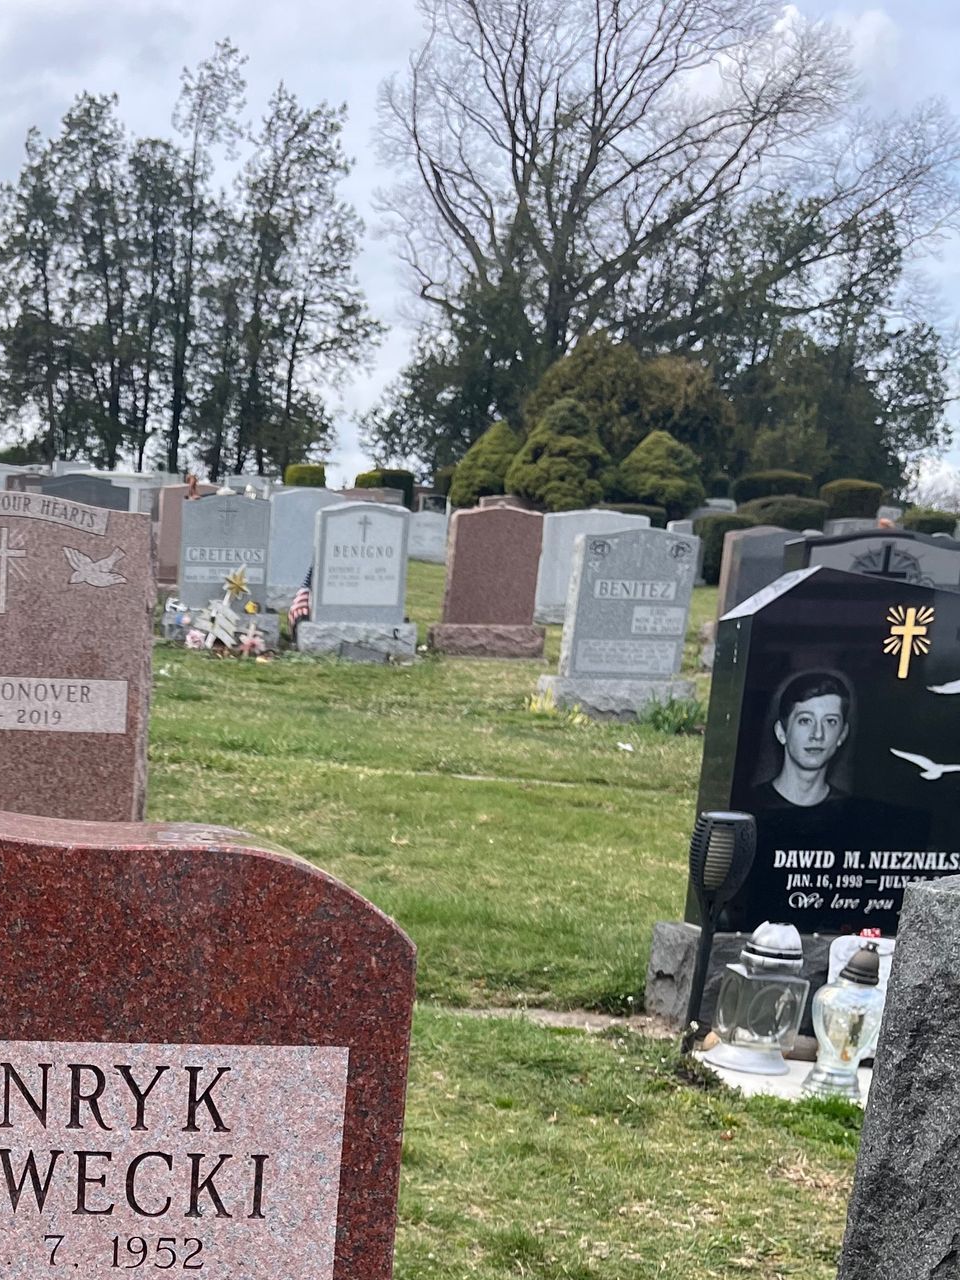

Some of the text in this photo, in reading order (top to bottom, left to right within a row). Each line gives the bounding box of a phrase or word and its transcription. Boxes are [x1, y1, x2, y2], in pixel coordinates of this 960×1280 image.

[1, 495, 32, 512] OUR
[40, 499, 98, 528] HEARTS
[333, 544, 394, 559] BENIGNO
[599, 581, 672, 599] BENITEZ
[16, 709, 63, 725] 2019
[773, 850, 960, 871] DAWID M. NIEZNALS
[786, 873, 814, 891] JAN.
[816, 874, 833, 891] 16,
[836, 874, 863, 889] 1998
[878, 874, 910, 892] JULY
[788, 891, 895, 915] We love you
[43, 1234, 80, 1269] 7,
[111, 1235, 205, 1270] 1952
